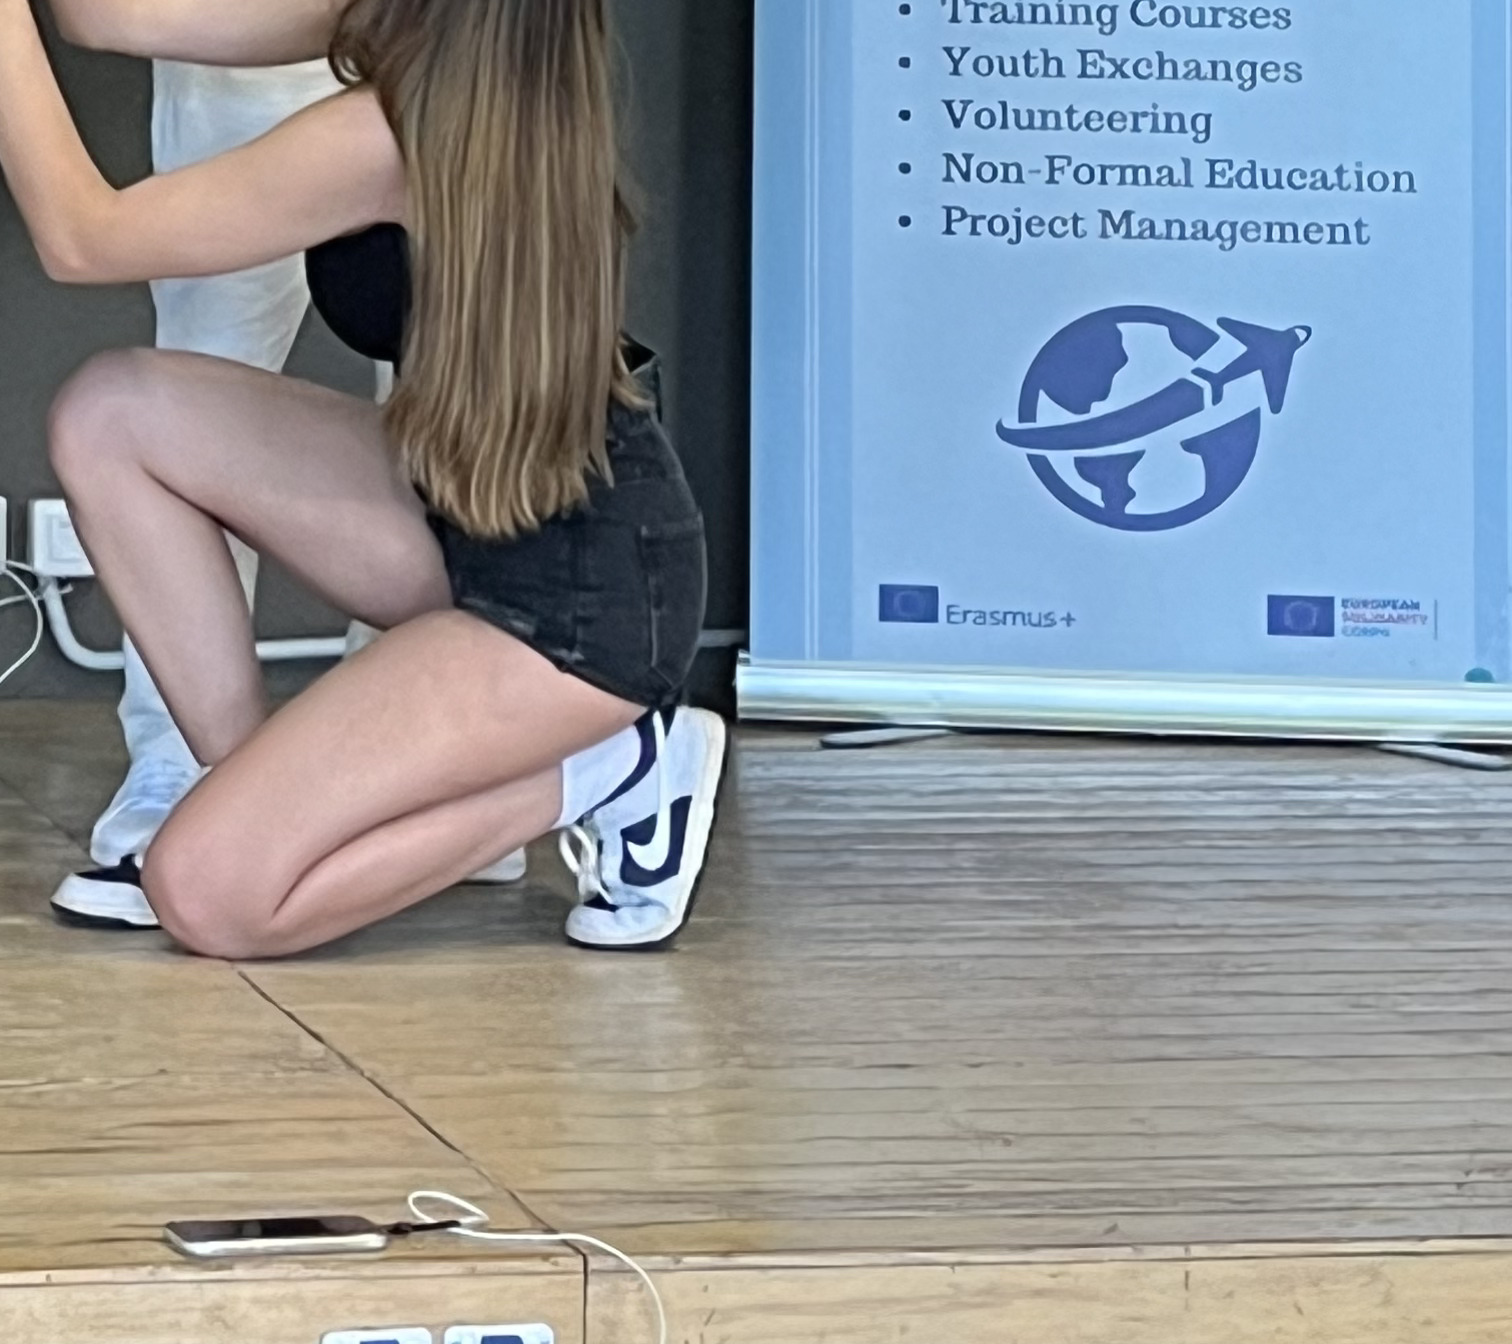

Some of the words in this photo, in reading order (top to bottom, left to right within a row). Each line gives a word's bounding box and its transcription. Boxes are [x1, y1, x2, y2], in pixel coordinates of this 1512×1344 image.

[942, 45, 1066, 80] Youth
[1076, 48, 1303, 91] Exchanges
[942, 99, 1213, 143] Volunteering
[941, 152, 1193, 189] Non-Formal
[1204, 157, 1418, 194] Education
[941, 205, 1087, 244] Project
[1097, 209, 1370, 251] Management
[945, 604, 1077, 628] Erasmus+
